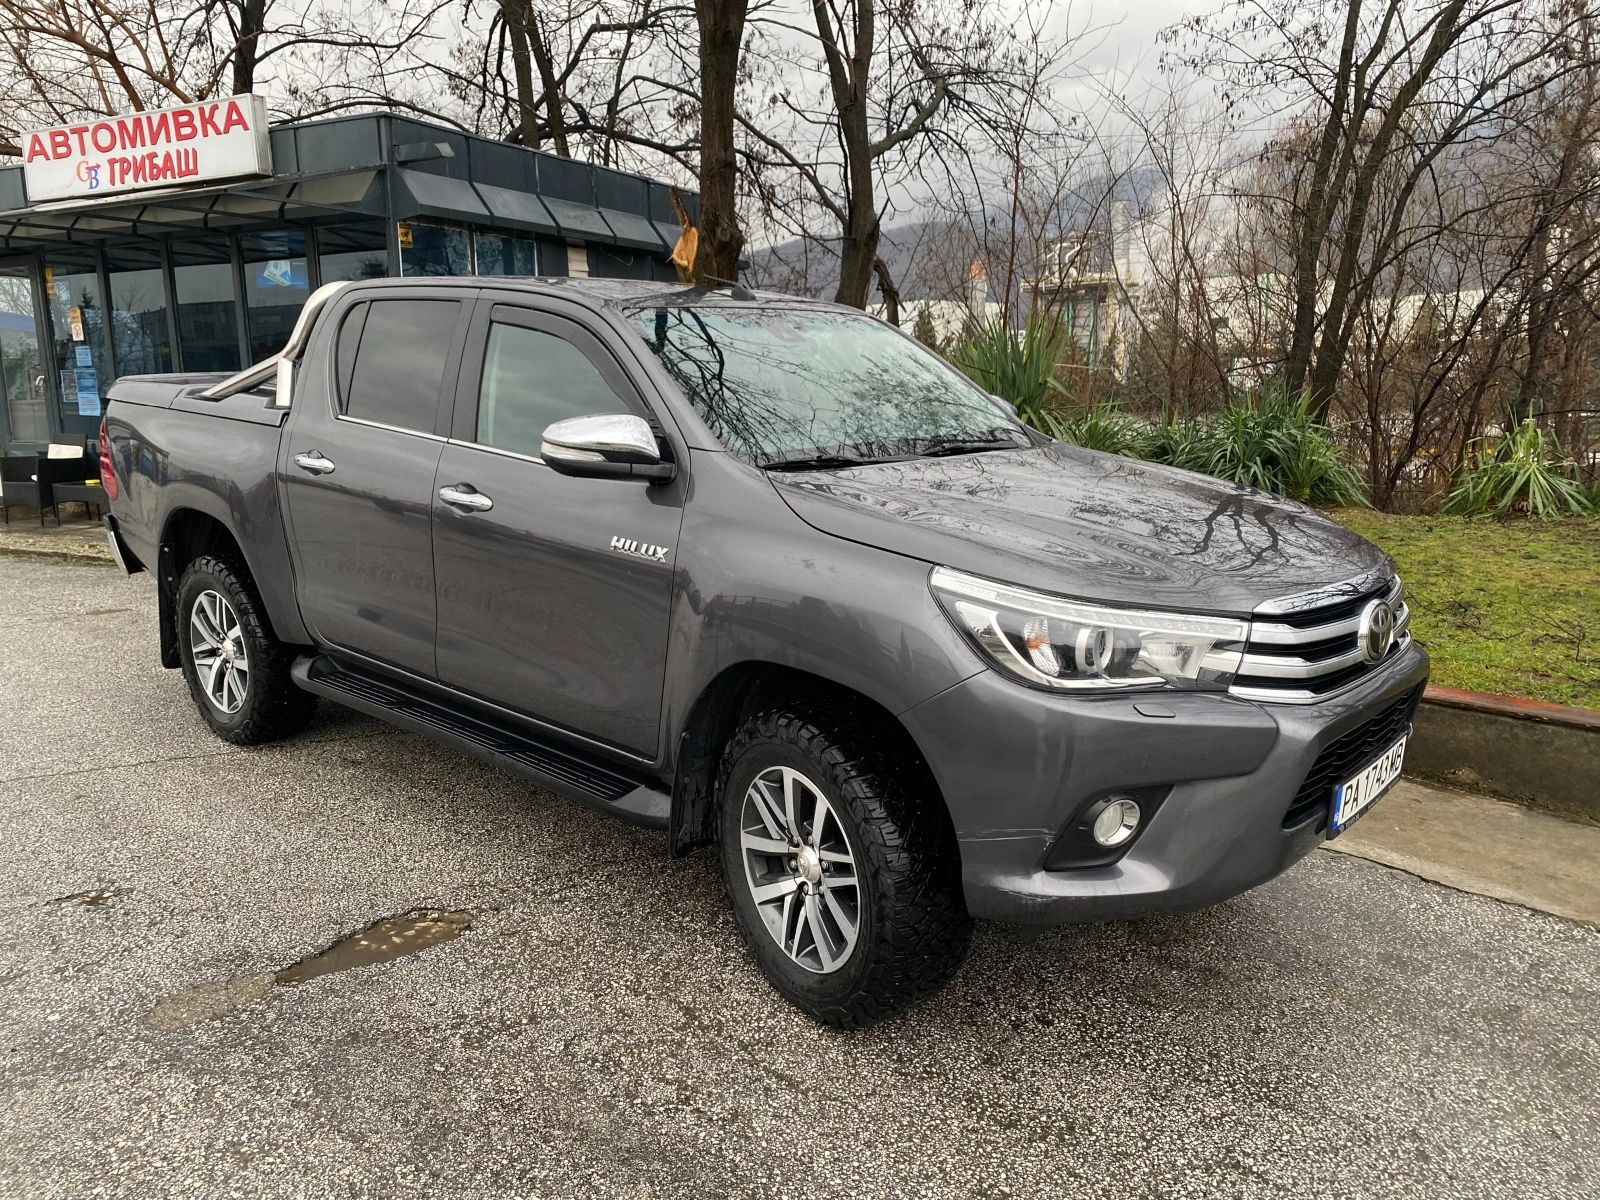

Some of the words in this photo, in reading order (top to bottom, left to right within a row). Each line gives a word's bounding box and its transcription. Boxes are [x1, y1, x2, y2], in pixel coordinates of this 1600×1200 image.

[26, 100, 250, 163] АВТОМИВКА
[107, 147, 199, 187] ГРИБАШ
[610, 535, 669, 563] HILUX
